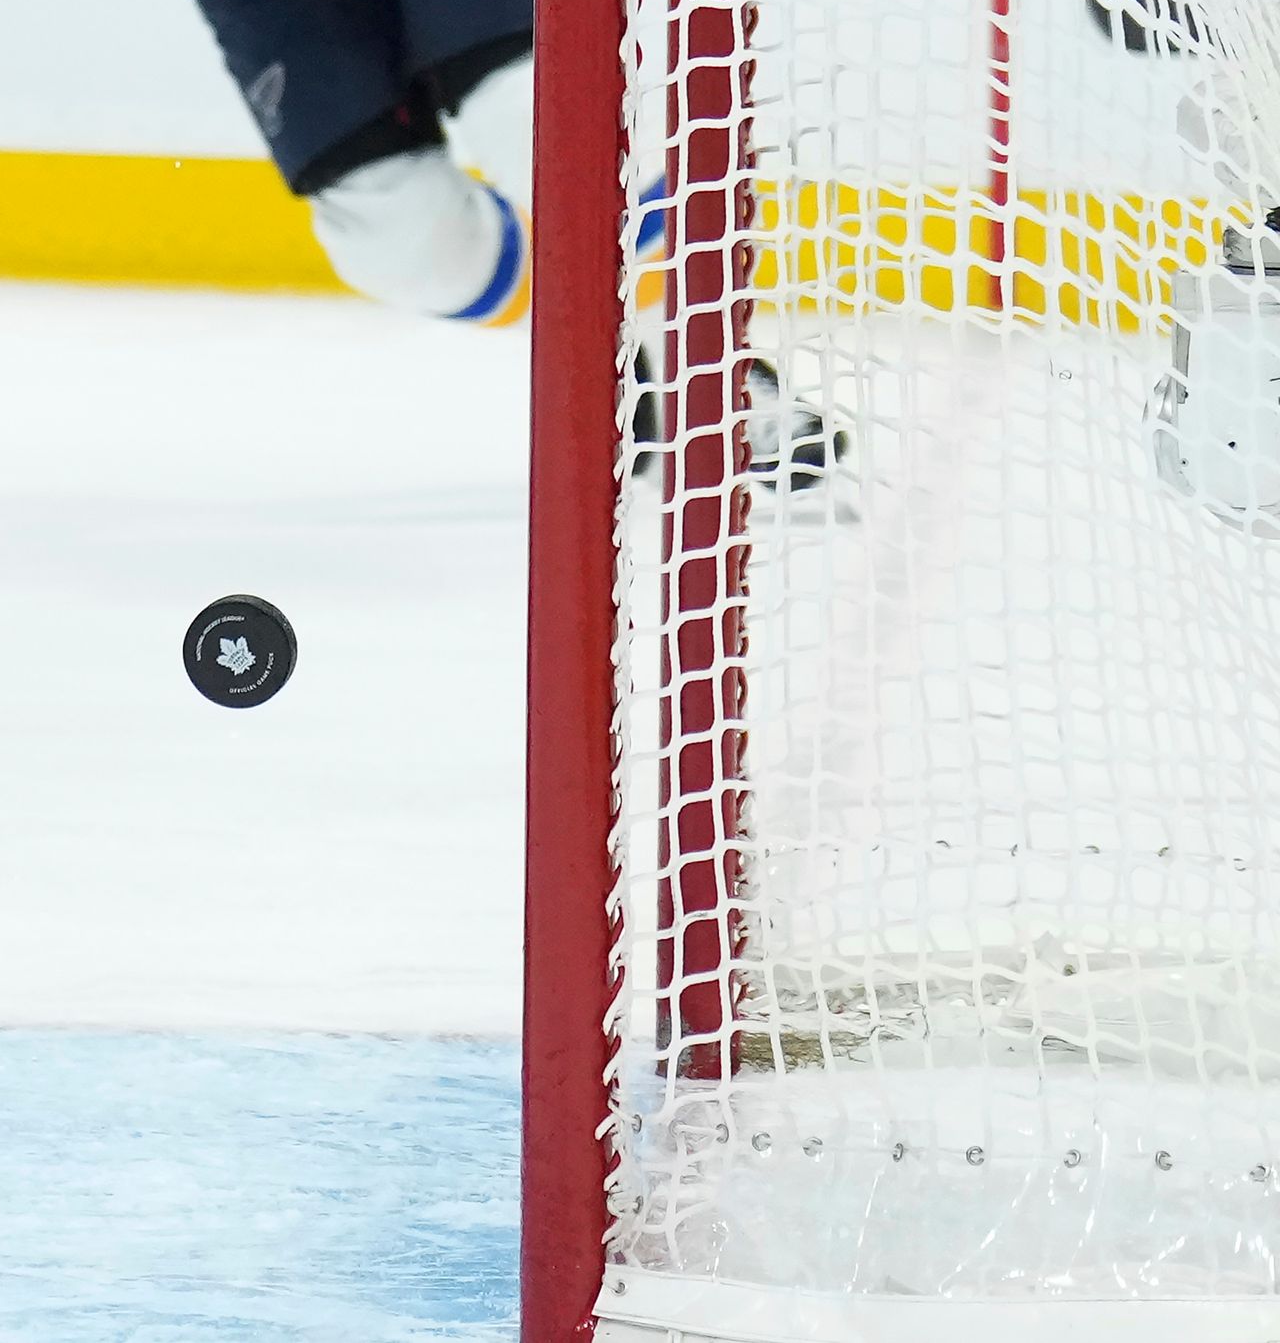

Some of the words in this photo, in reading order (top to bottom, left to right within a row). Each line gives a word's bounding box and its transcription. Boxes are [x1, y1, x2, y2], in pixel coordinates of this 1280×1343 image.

[228, 683, 257, 695] OFFICIAL
[256, 670, 270, 686] GAME
[267, 652, 276, 671] PUCK
